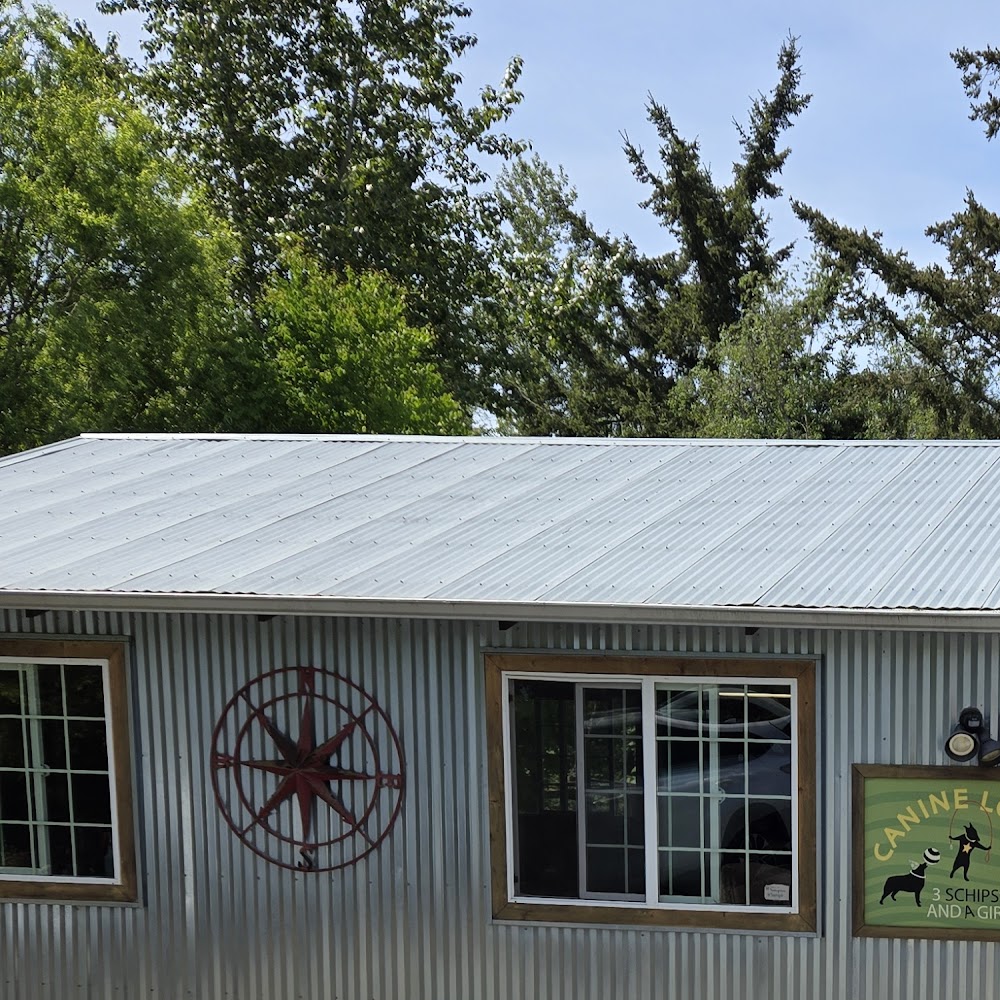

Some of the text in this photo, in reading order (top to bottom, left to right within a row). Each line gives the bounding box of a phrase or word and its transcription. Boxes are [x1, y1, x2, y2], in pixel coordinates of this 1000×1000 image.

[873, 788, 969, 862] CANINE
[932, 887, 941, 901] 3
[926, 903, 962, 918] AND
[964, 904, 975, 919] A
